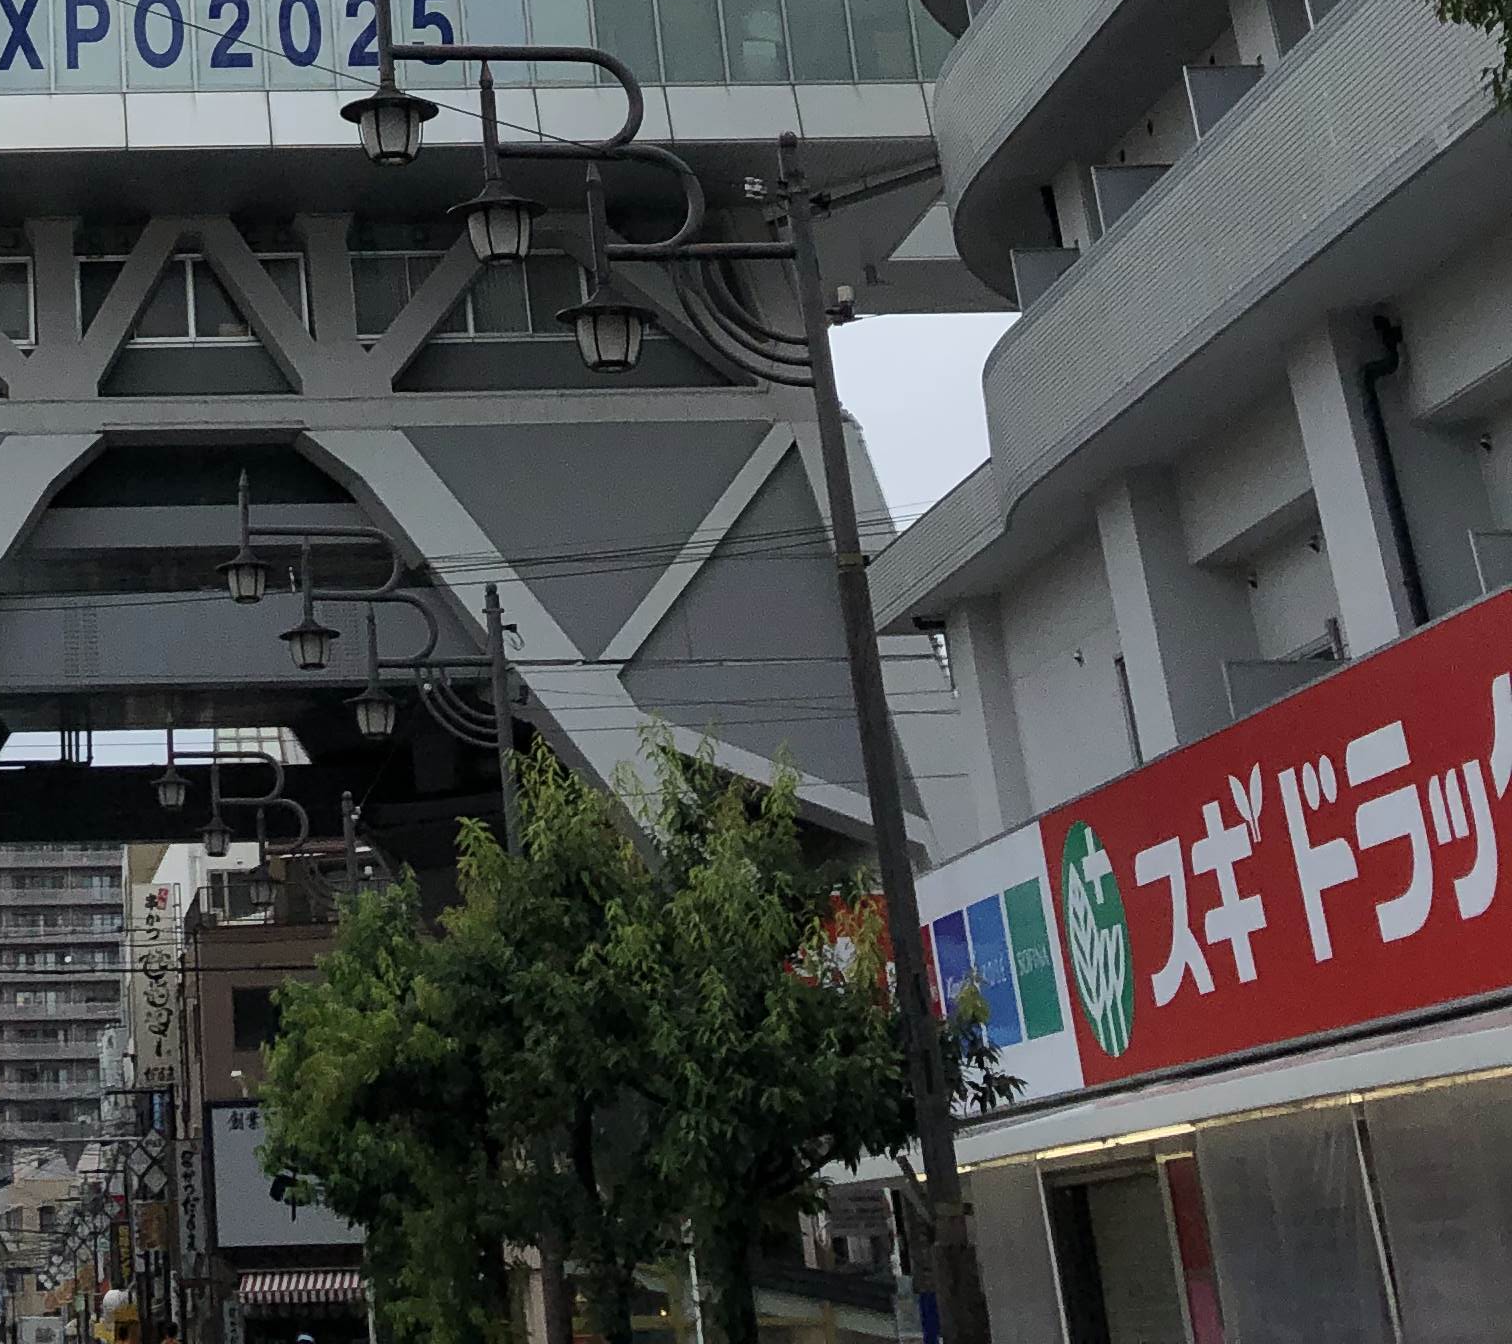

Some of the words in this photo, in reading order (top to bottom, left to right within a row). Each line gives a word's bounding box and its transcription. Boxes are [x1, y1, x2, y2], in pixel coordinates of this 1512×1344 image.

[1134, 674, 1512, 1007] スギドラッ
